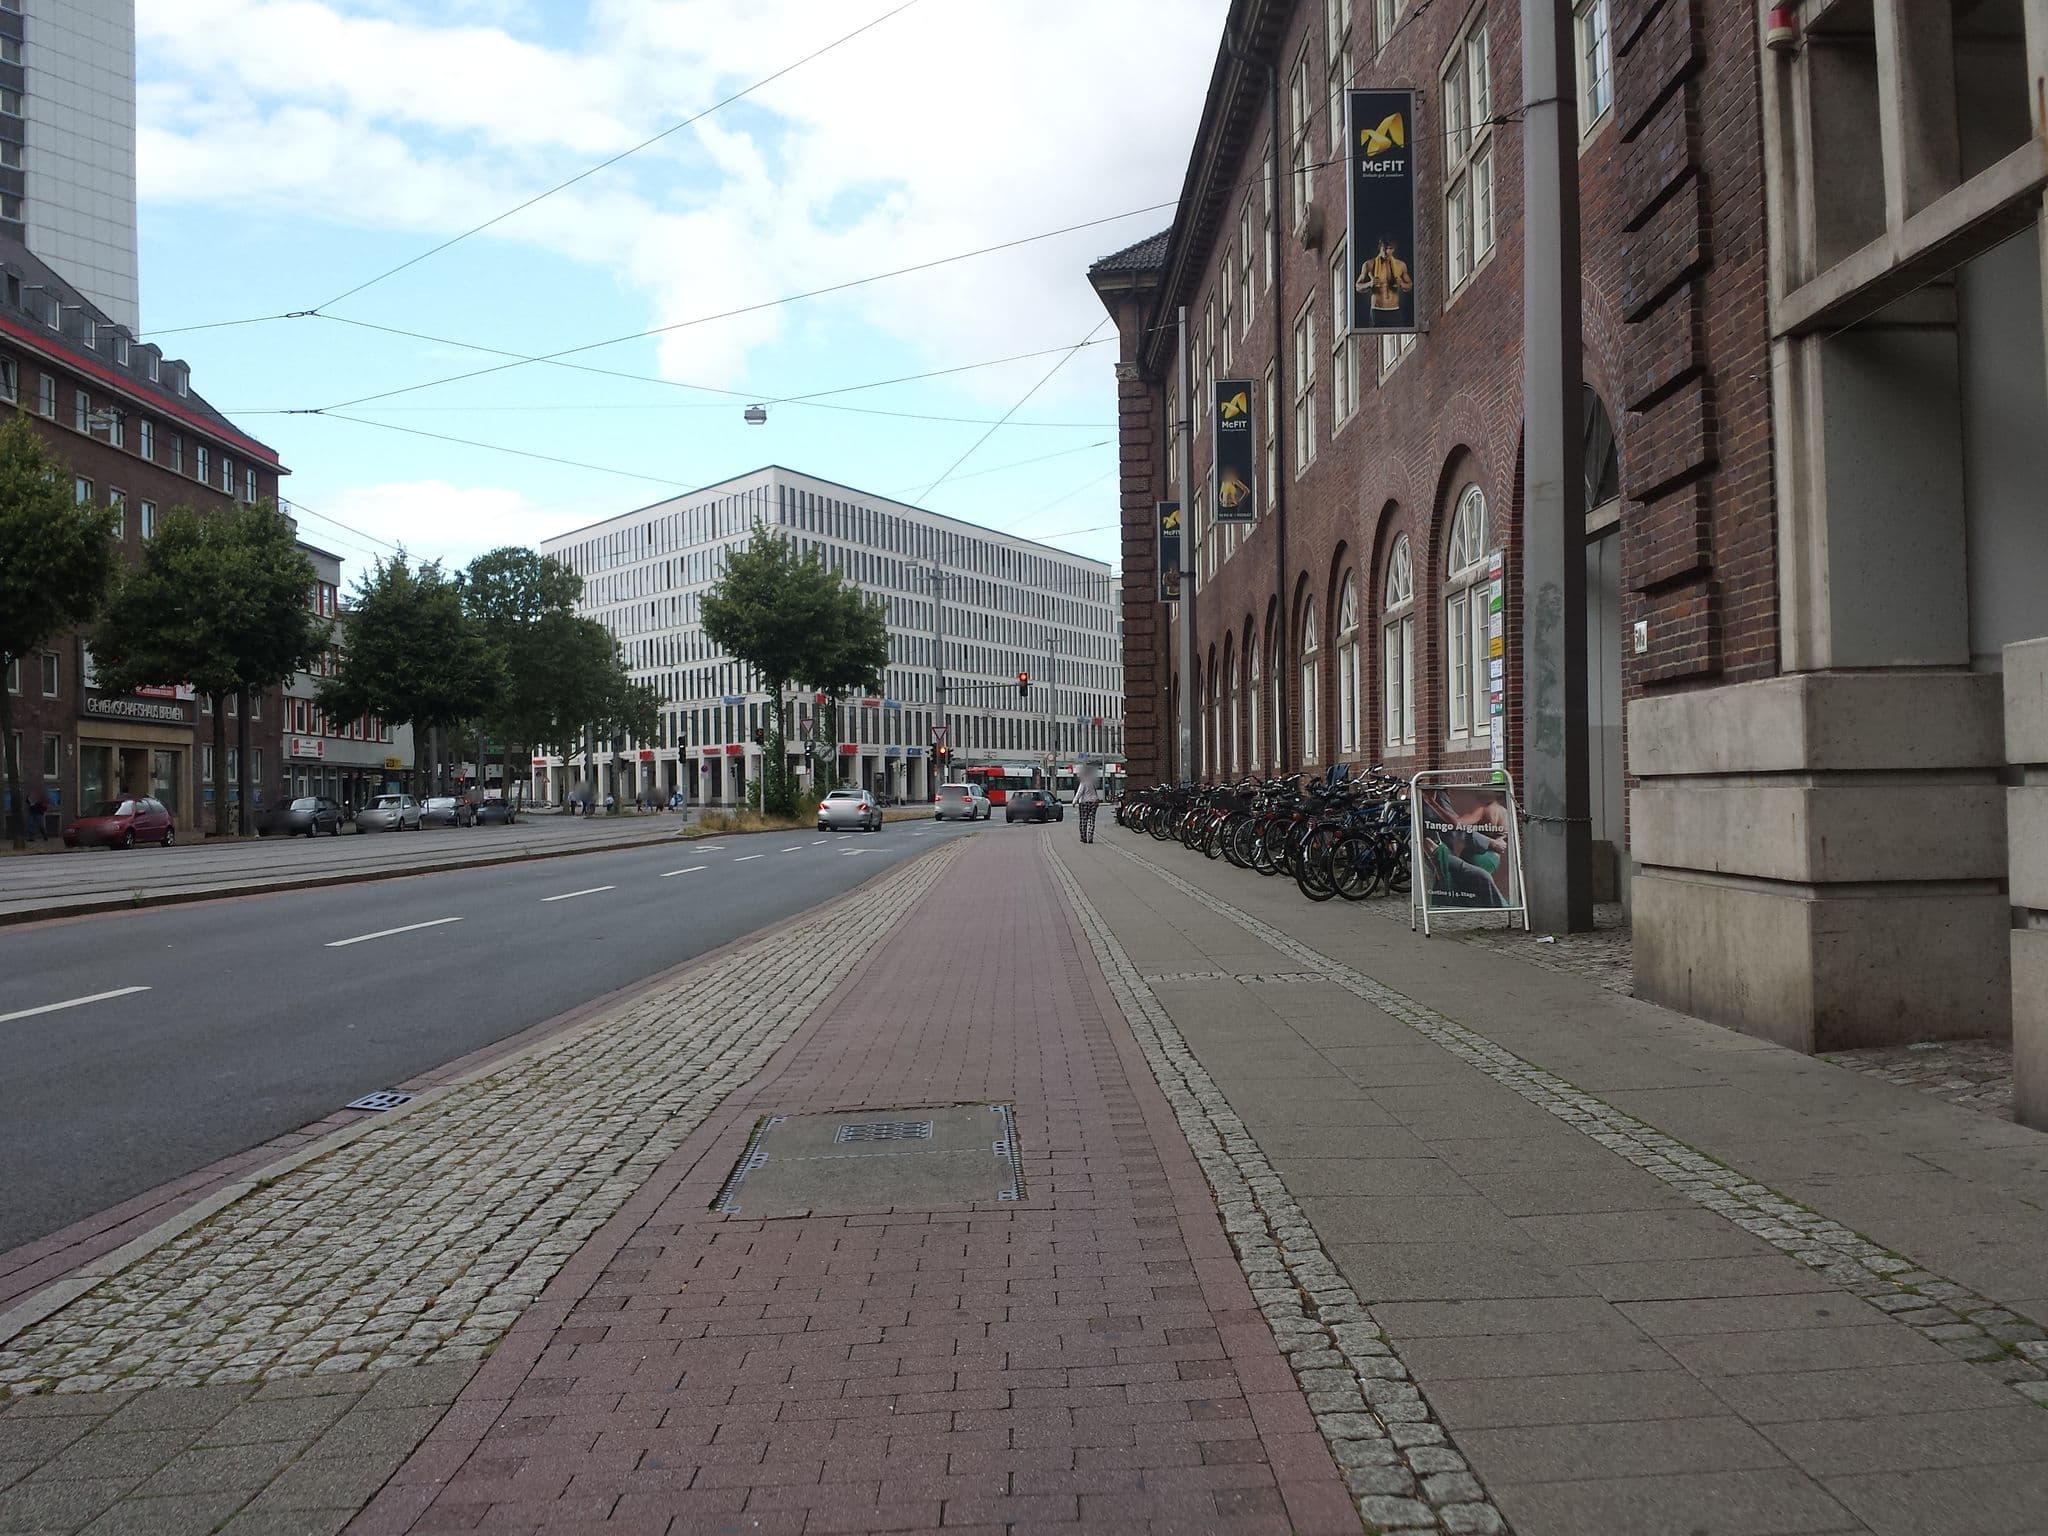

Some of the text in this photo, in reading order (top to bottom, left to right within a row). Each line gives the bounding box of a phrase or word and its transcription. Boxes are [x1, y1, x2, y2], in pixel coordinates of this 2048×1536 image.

[1362, 160, 1405, 172] McFIT
[1221, 420, 1247, 429] McFIT
[1425, 821, 1504, 833] Tango Argentino
